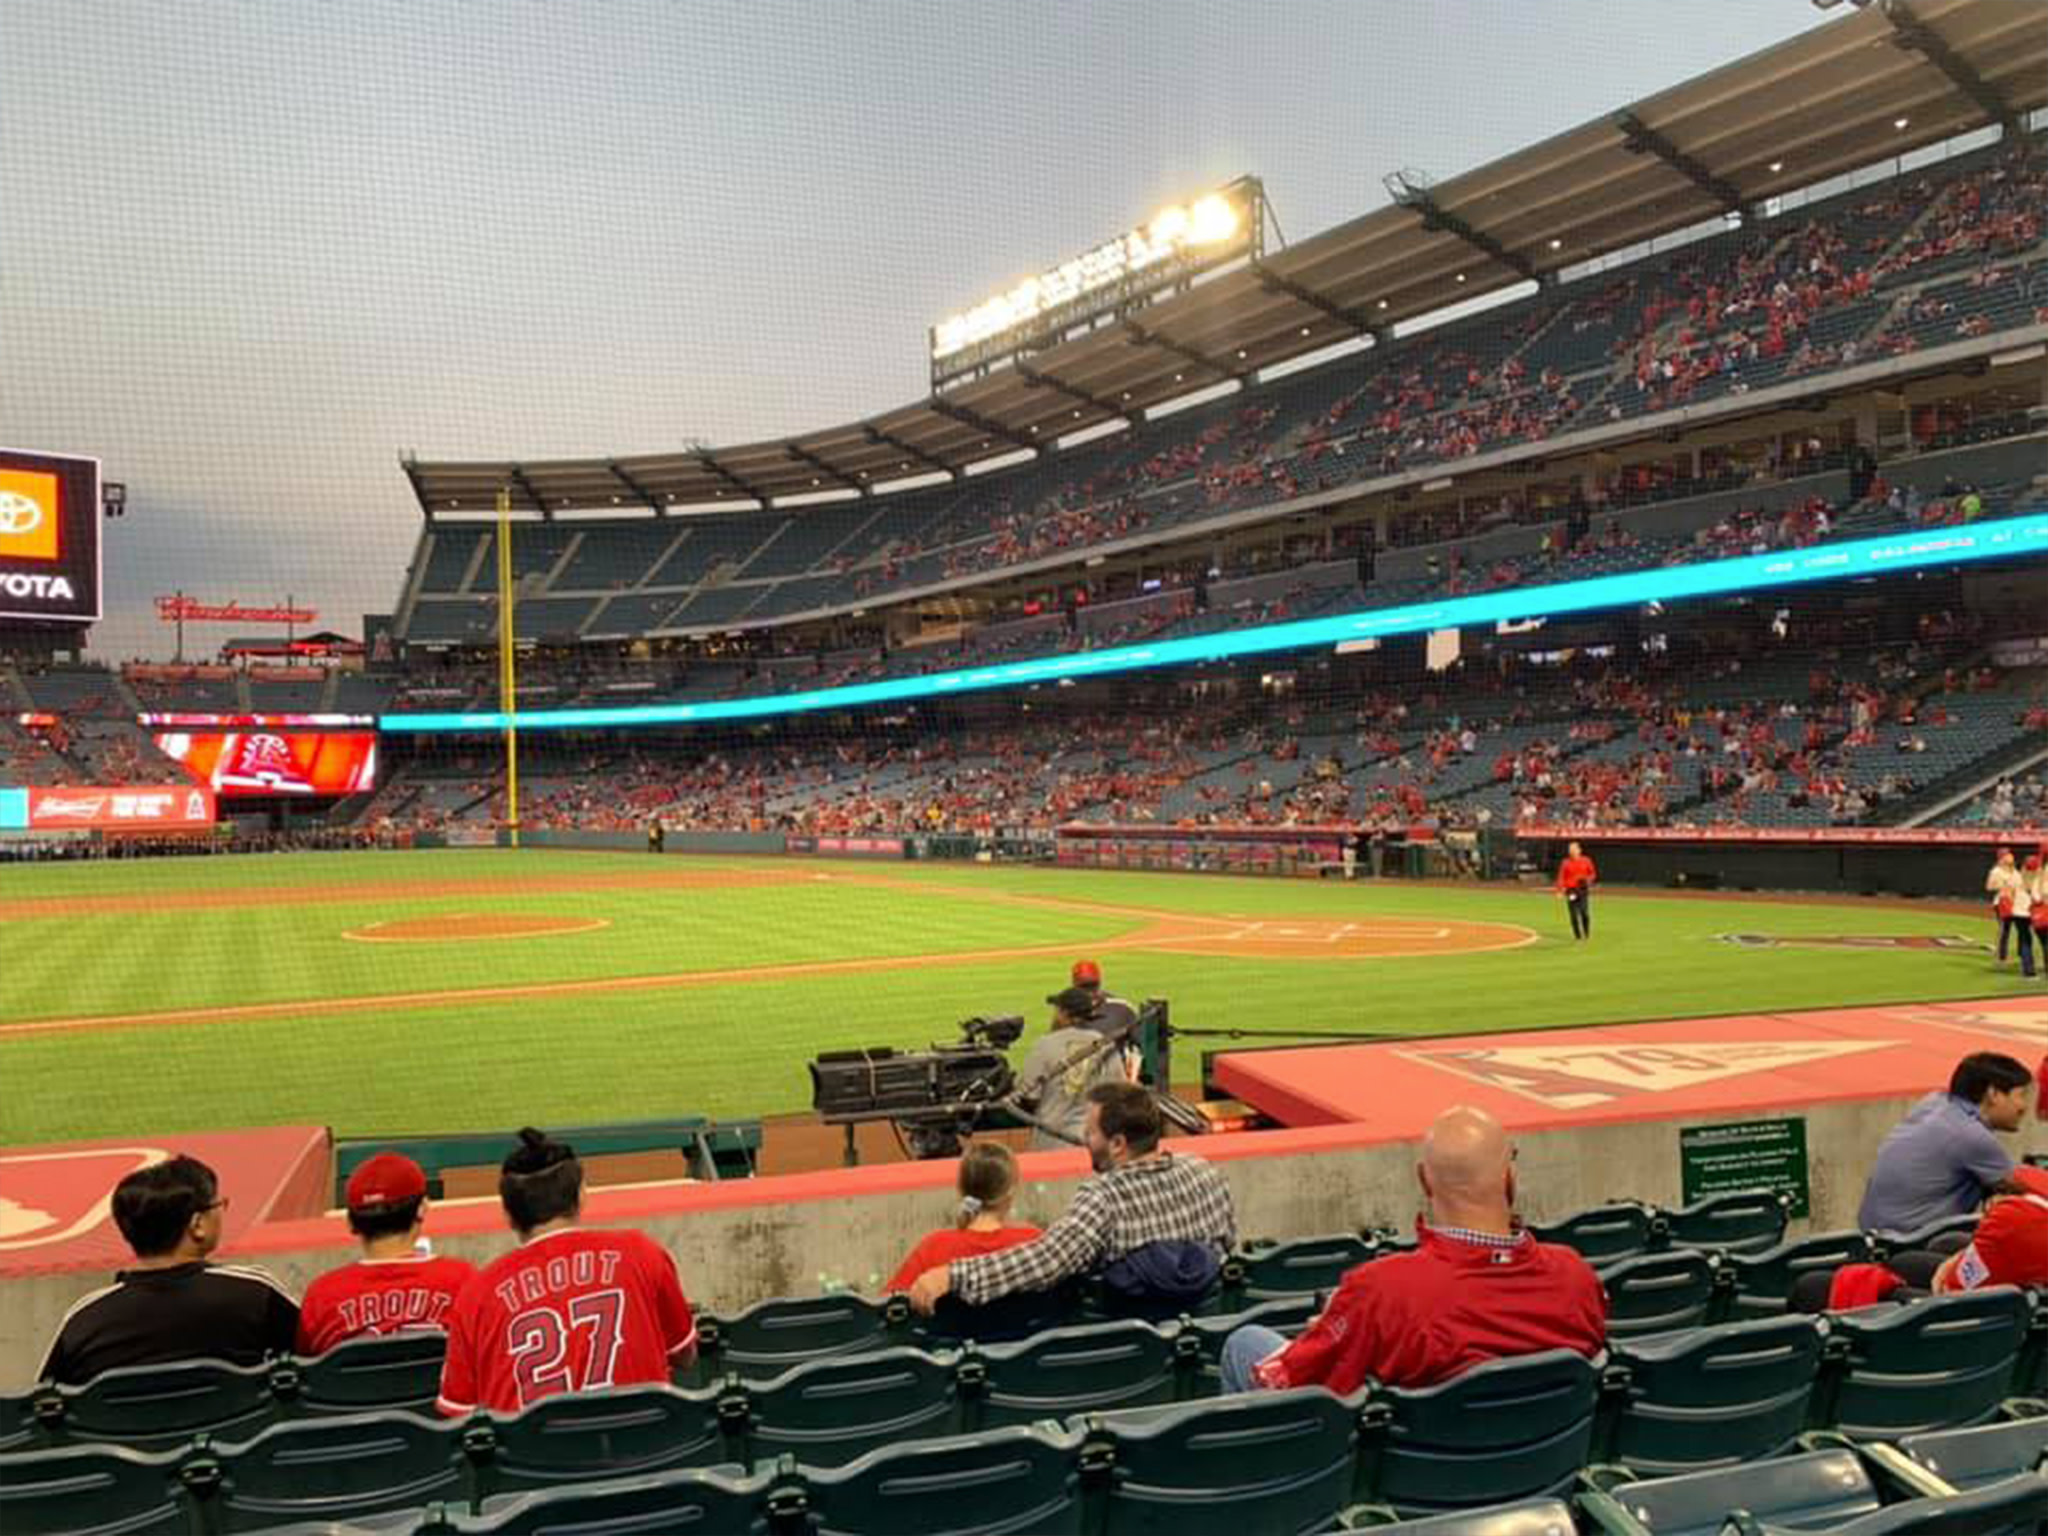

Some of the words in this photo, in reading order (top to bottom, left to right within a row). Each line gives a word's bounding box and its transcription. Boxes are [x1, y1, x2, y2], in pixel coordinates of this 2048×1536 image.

[339, 1288, 451, 1331] TROUT
[495, 1250, 621, 1313] TROUT
[508, 1288, 624, 1411] 27
